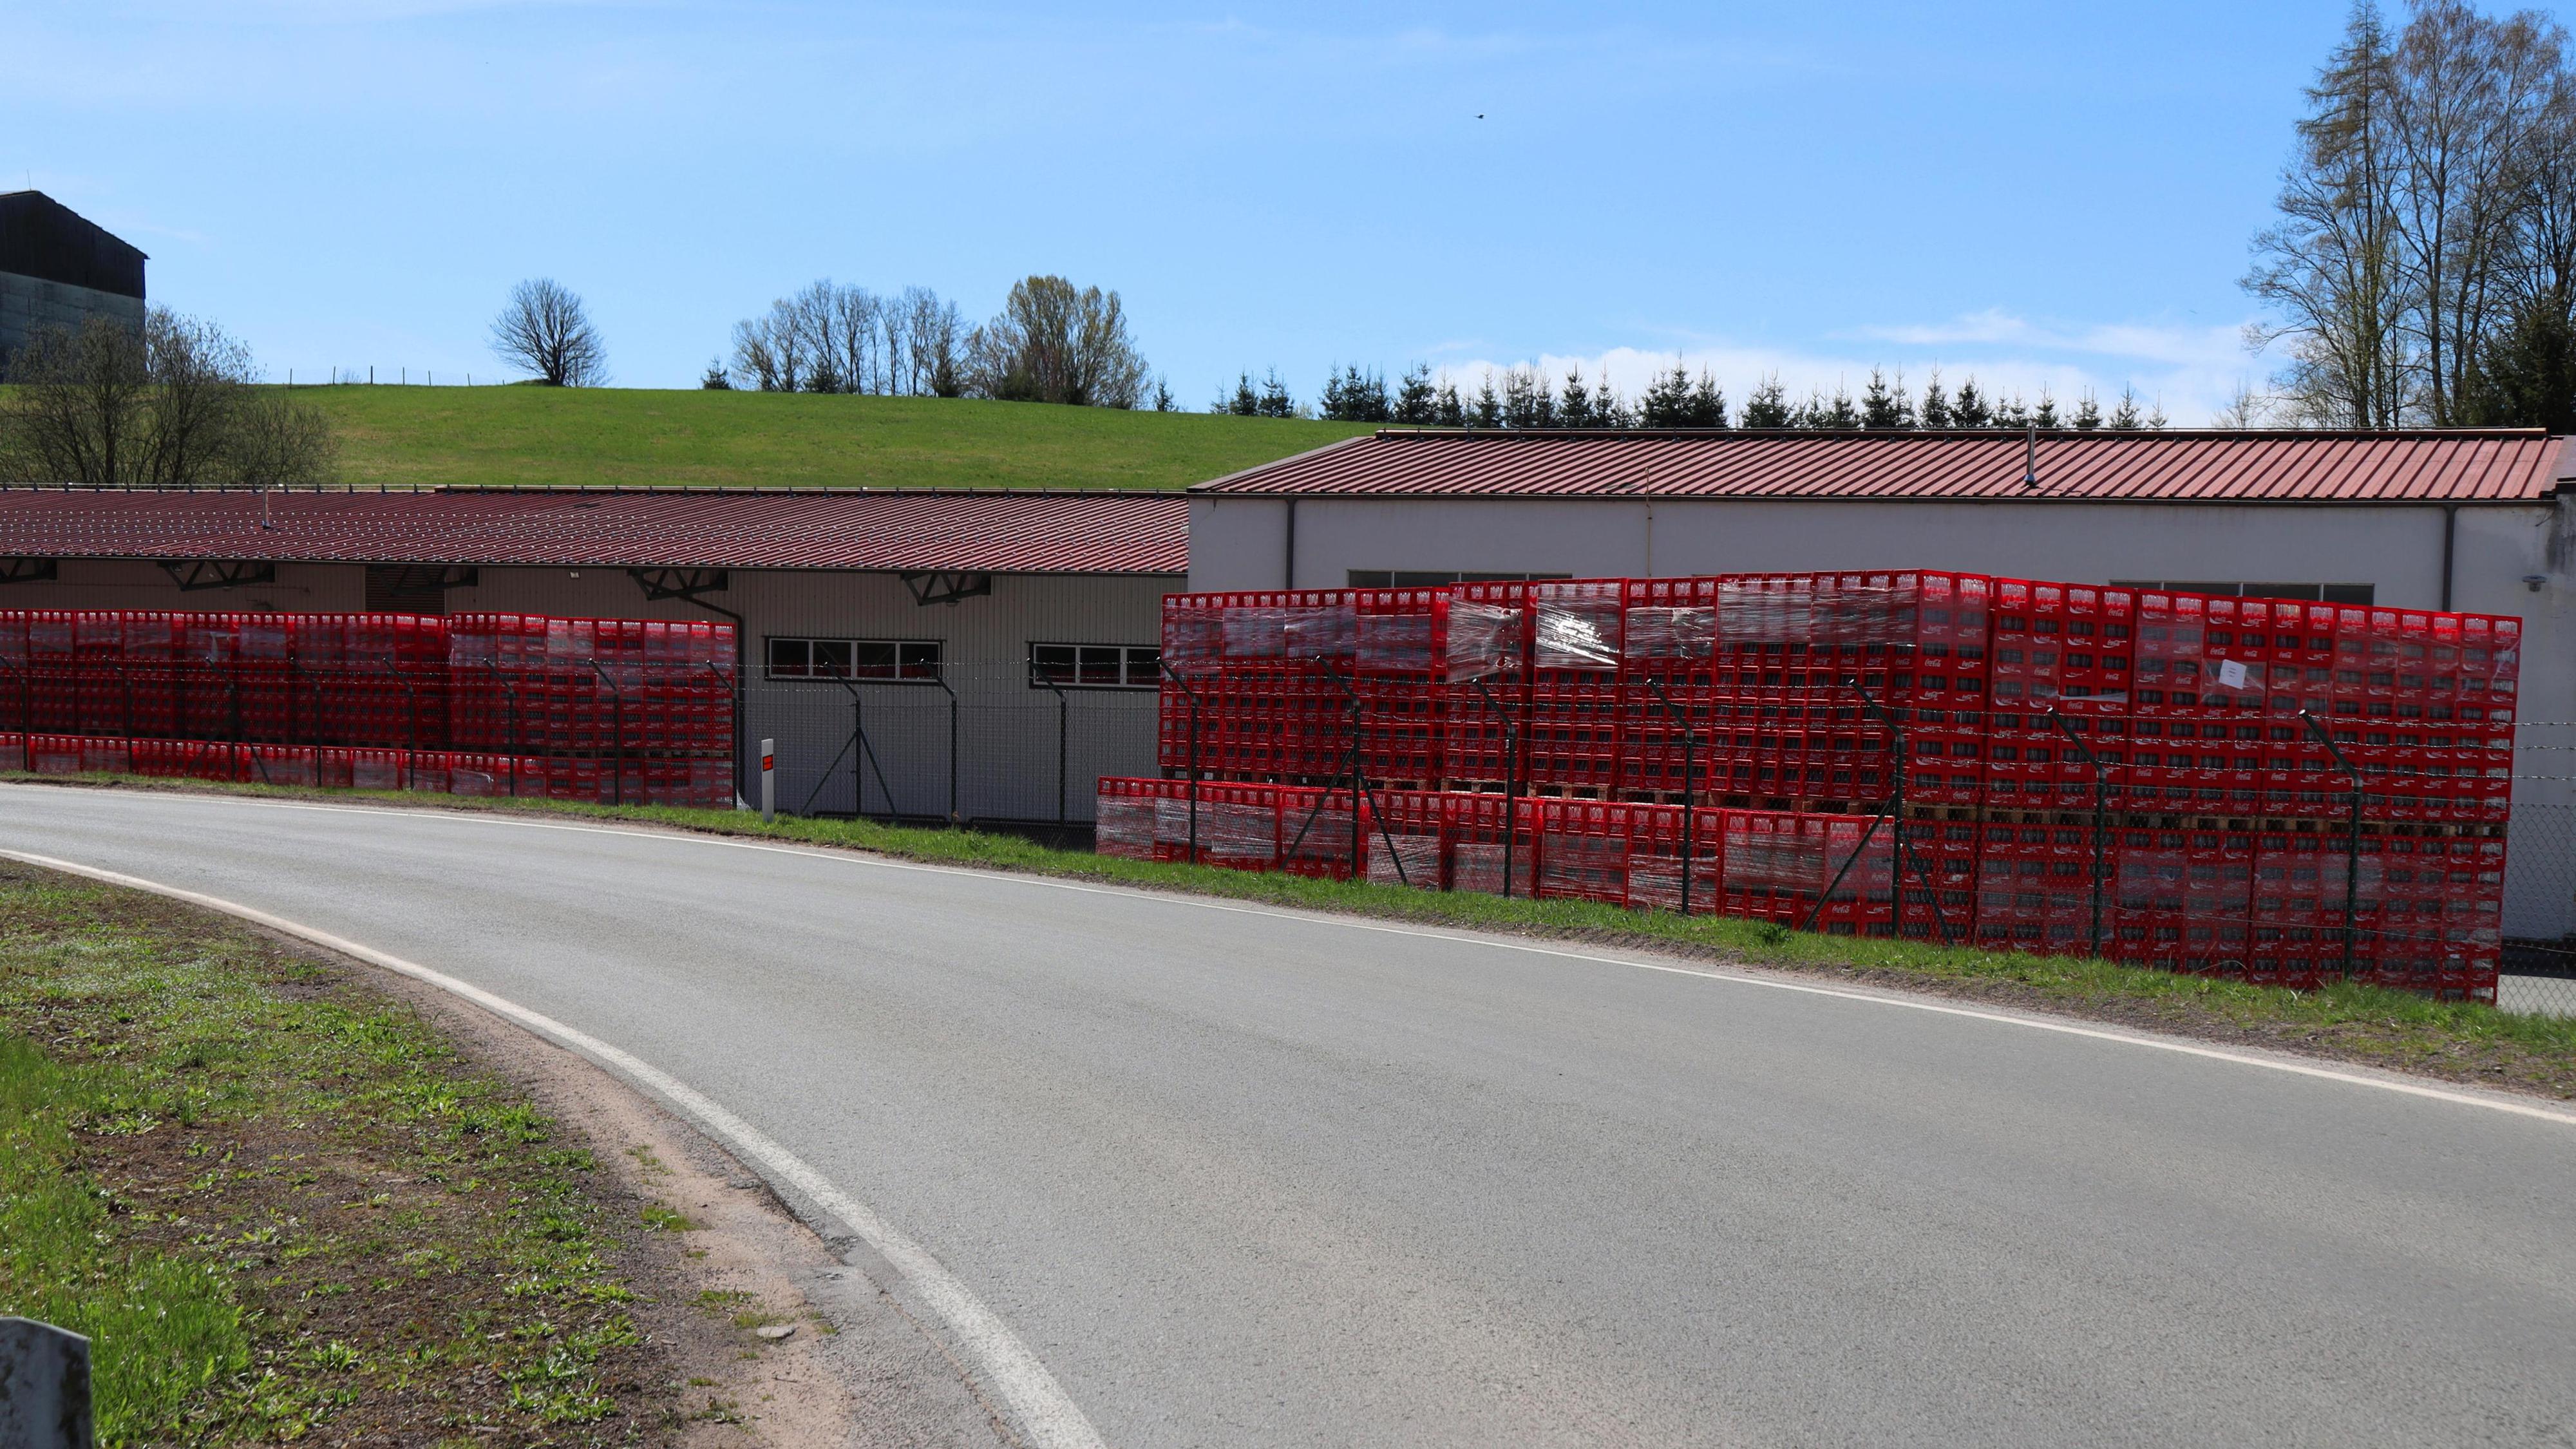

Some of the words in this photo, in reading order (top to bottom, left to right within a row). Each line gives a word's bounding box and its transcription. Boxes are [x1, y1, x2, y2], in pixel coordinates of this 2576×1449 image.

[2108, 608, 2125, 617] Coca-Cola
[2210, 647, 2226, 656] Coca-Cola
[1924, 658, 1942, 667] Coca-Cola
[2067, 701, 2084, 709] Coca-Cola
[2065, 765, 2081, 773] Coca-Cola
[1832, 905, 1850, 914] Coca-Cola
